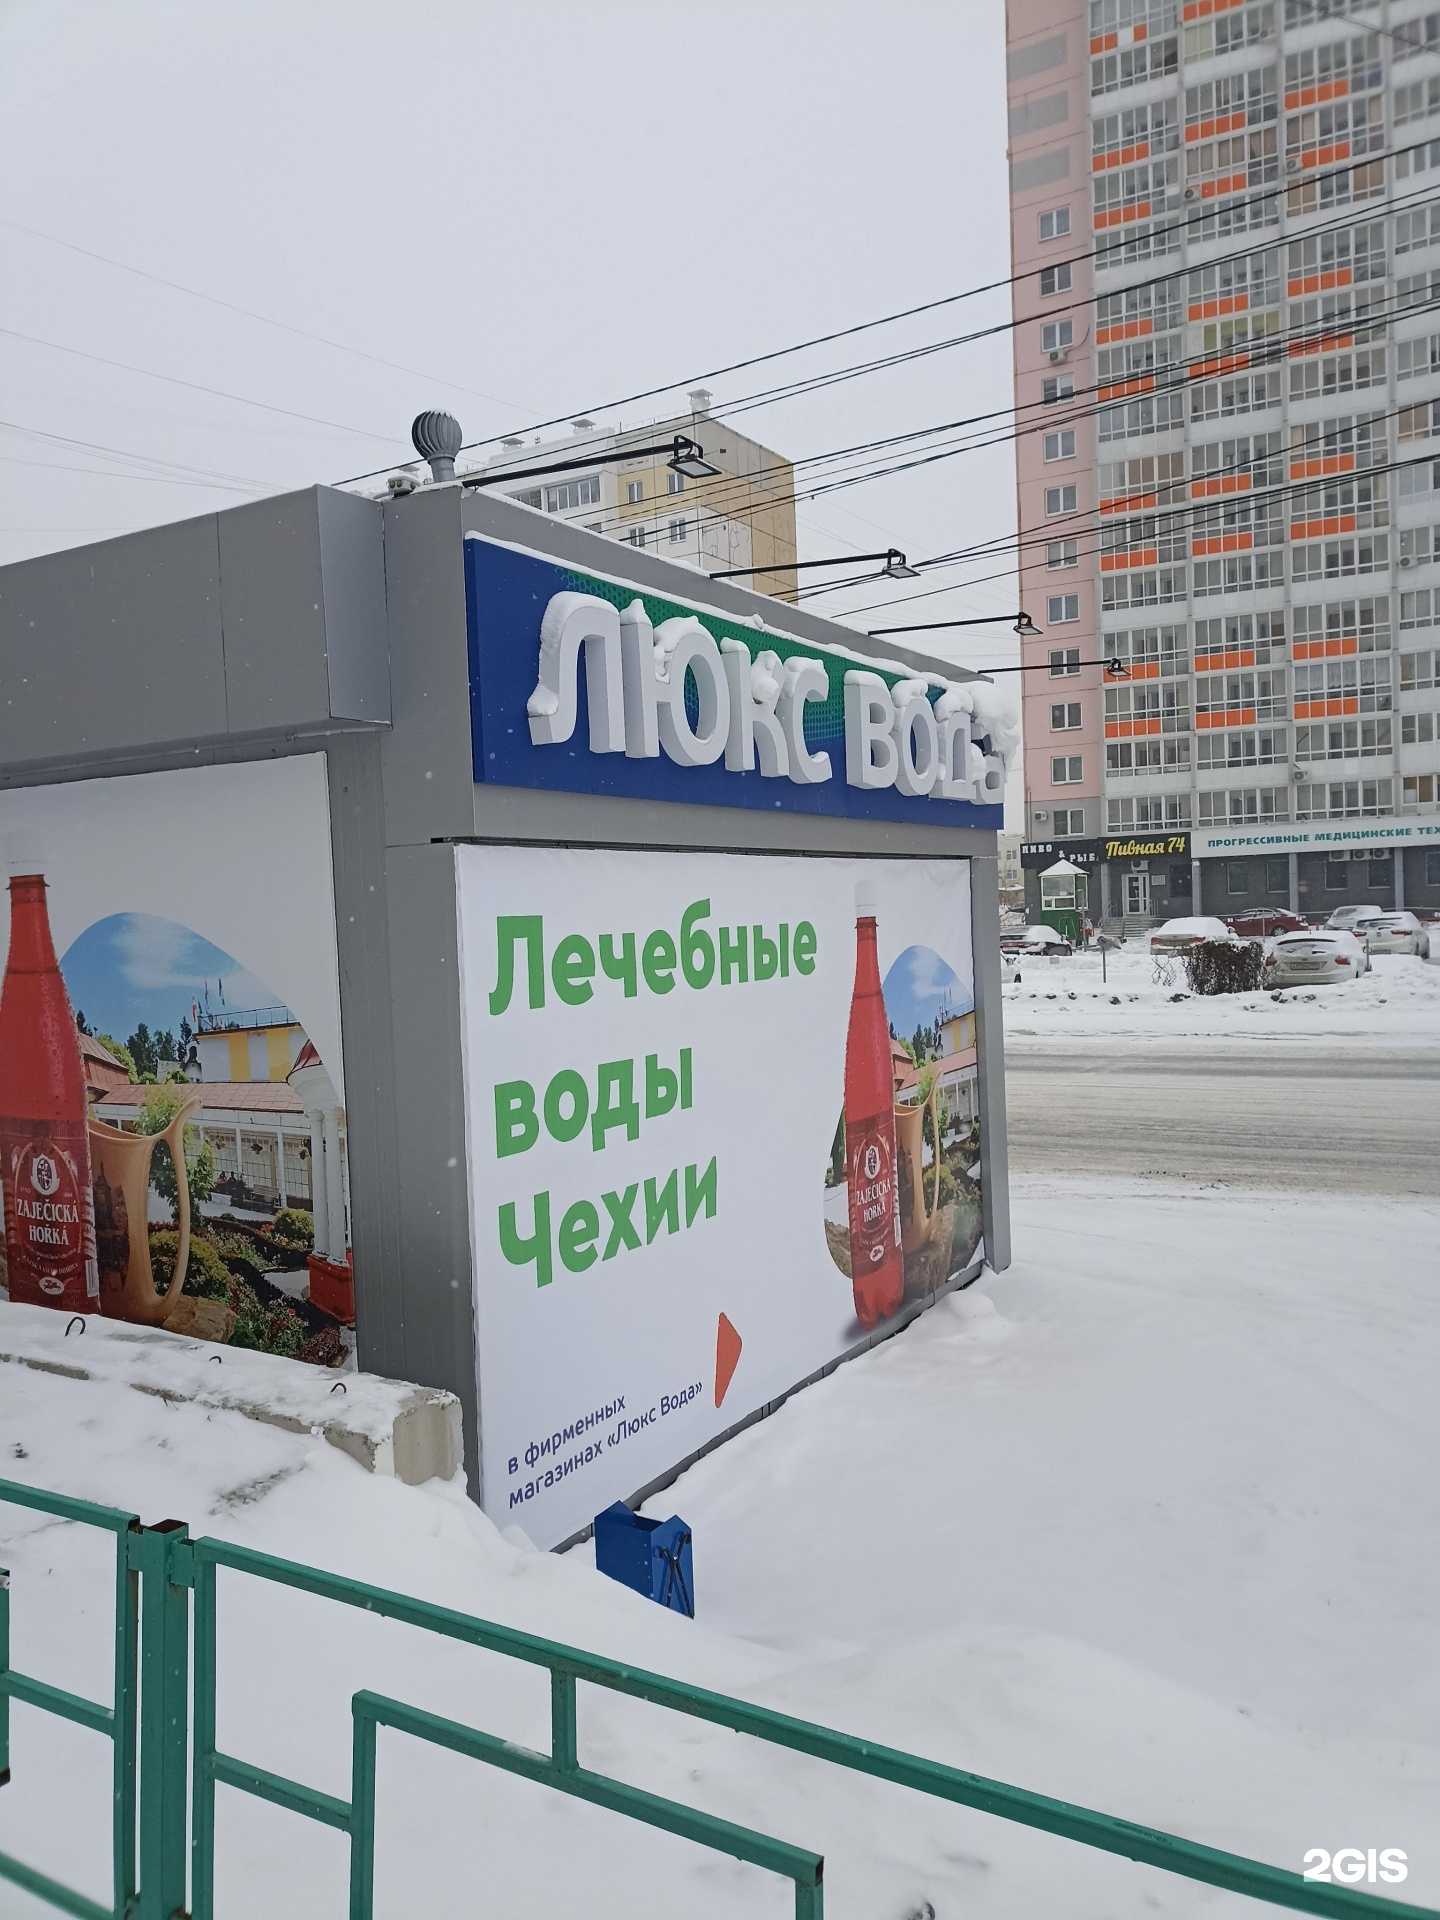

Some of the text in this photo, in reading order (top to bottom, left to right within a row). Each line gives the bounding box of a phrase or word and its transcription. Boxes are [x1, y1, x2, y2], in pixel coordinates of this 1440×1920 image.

[1022, 844, 1053, 854] ПИВО
[1105, 836, 1186, 857] Пивная 74
[1207, 834, 1310, 848] ПРОГРЕССИВНЫЕ
[1314, 827, 1412, 842] МЕДИЦИНСКИЕ
[488, 897, 818, 1016] Лечебные
[493, 1047, 694, 1159] воды
[16, 1198, 80, 1223] ZAJEČICKÁ
[498, 1155, 718, 1289] Чехии
[507, 1395, 626, 1475] в фирменных
[508, 1381, 703, 1508] магазинах «Люкс Вода»
